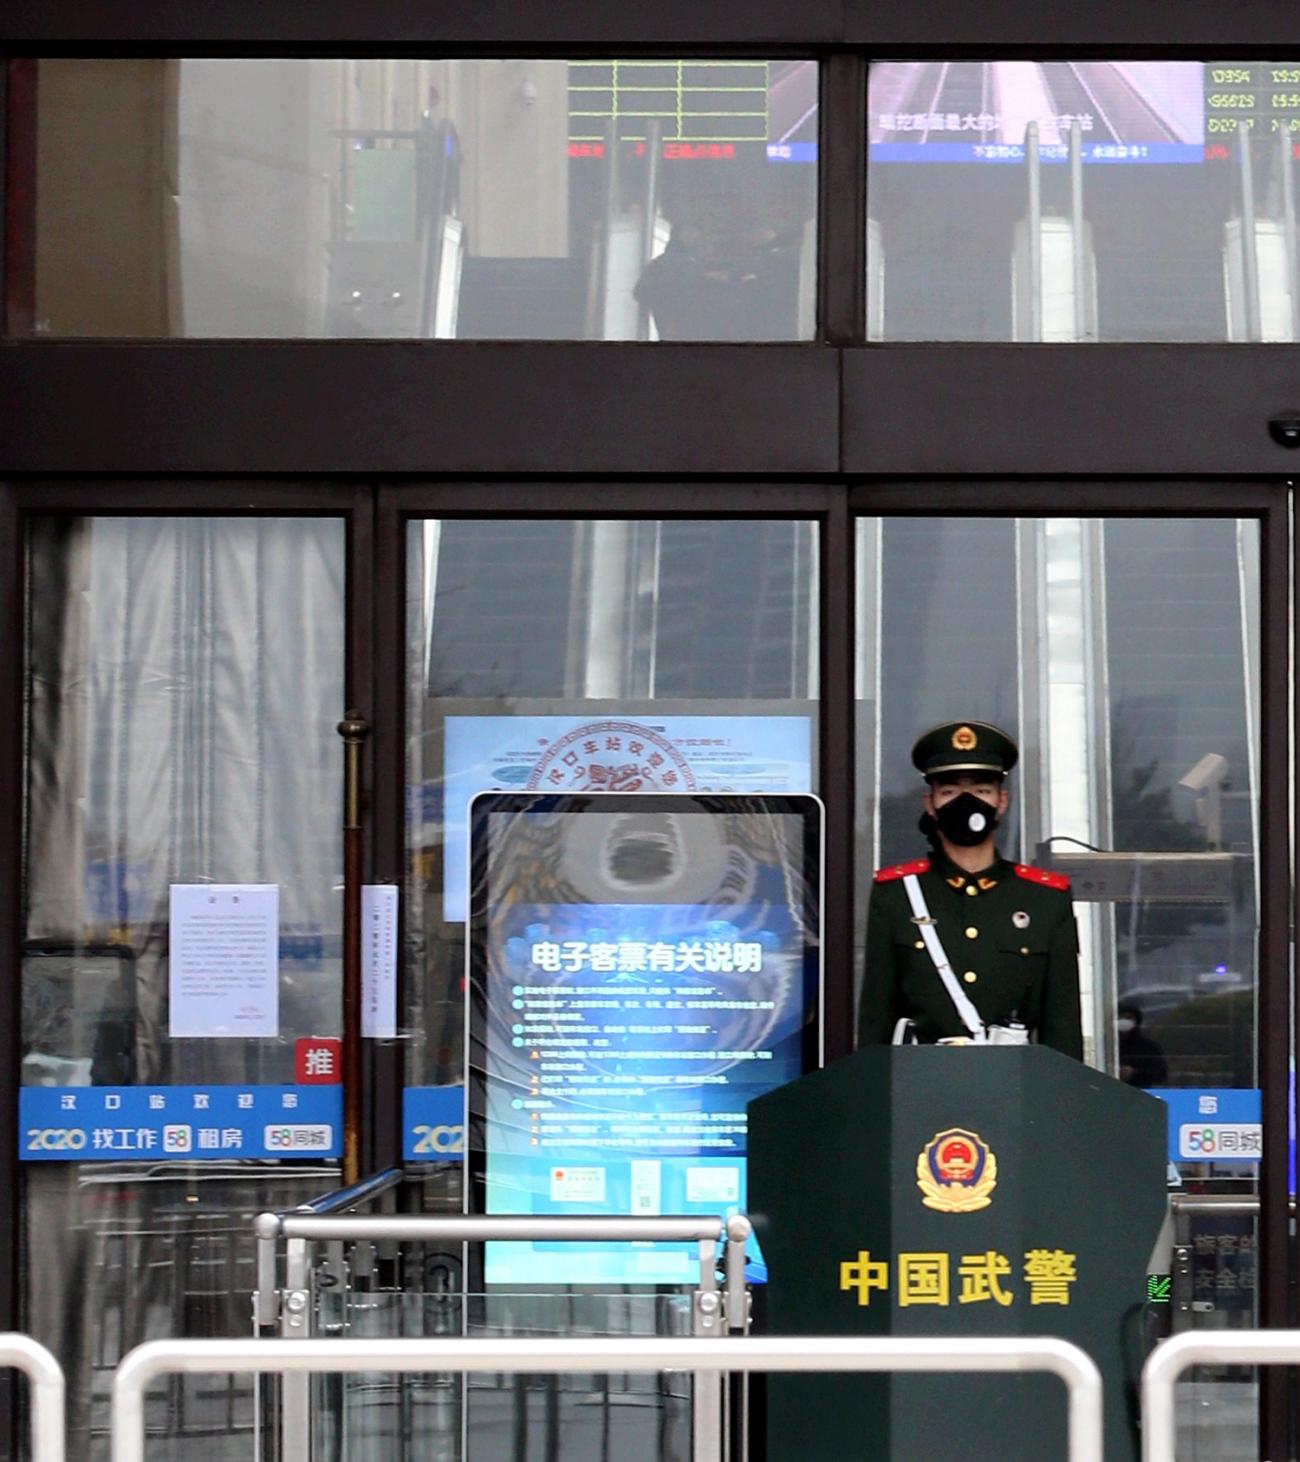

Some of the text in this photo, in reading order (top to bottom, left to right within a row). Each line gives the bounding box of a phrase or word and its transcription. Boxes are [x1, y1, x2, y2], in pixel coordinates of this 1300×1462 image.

[531, 941, 762, 973] 电子客票有关说明
[304, 1049, 334, 1076] 推
[60, 1094, 298, 1110] 汉口站欢迎您
[1198, 1096, 1218, 1114] 您
[27, 1127, 327, 1150] 2020 找工作 58 租房 58同城
[1188, 1128, 1262, 1153] 58同城
[839, 1248, 1077, 1307] 中国武警
